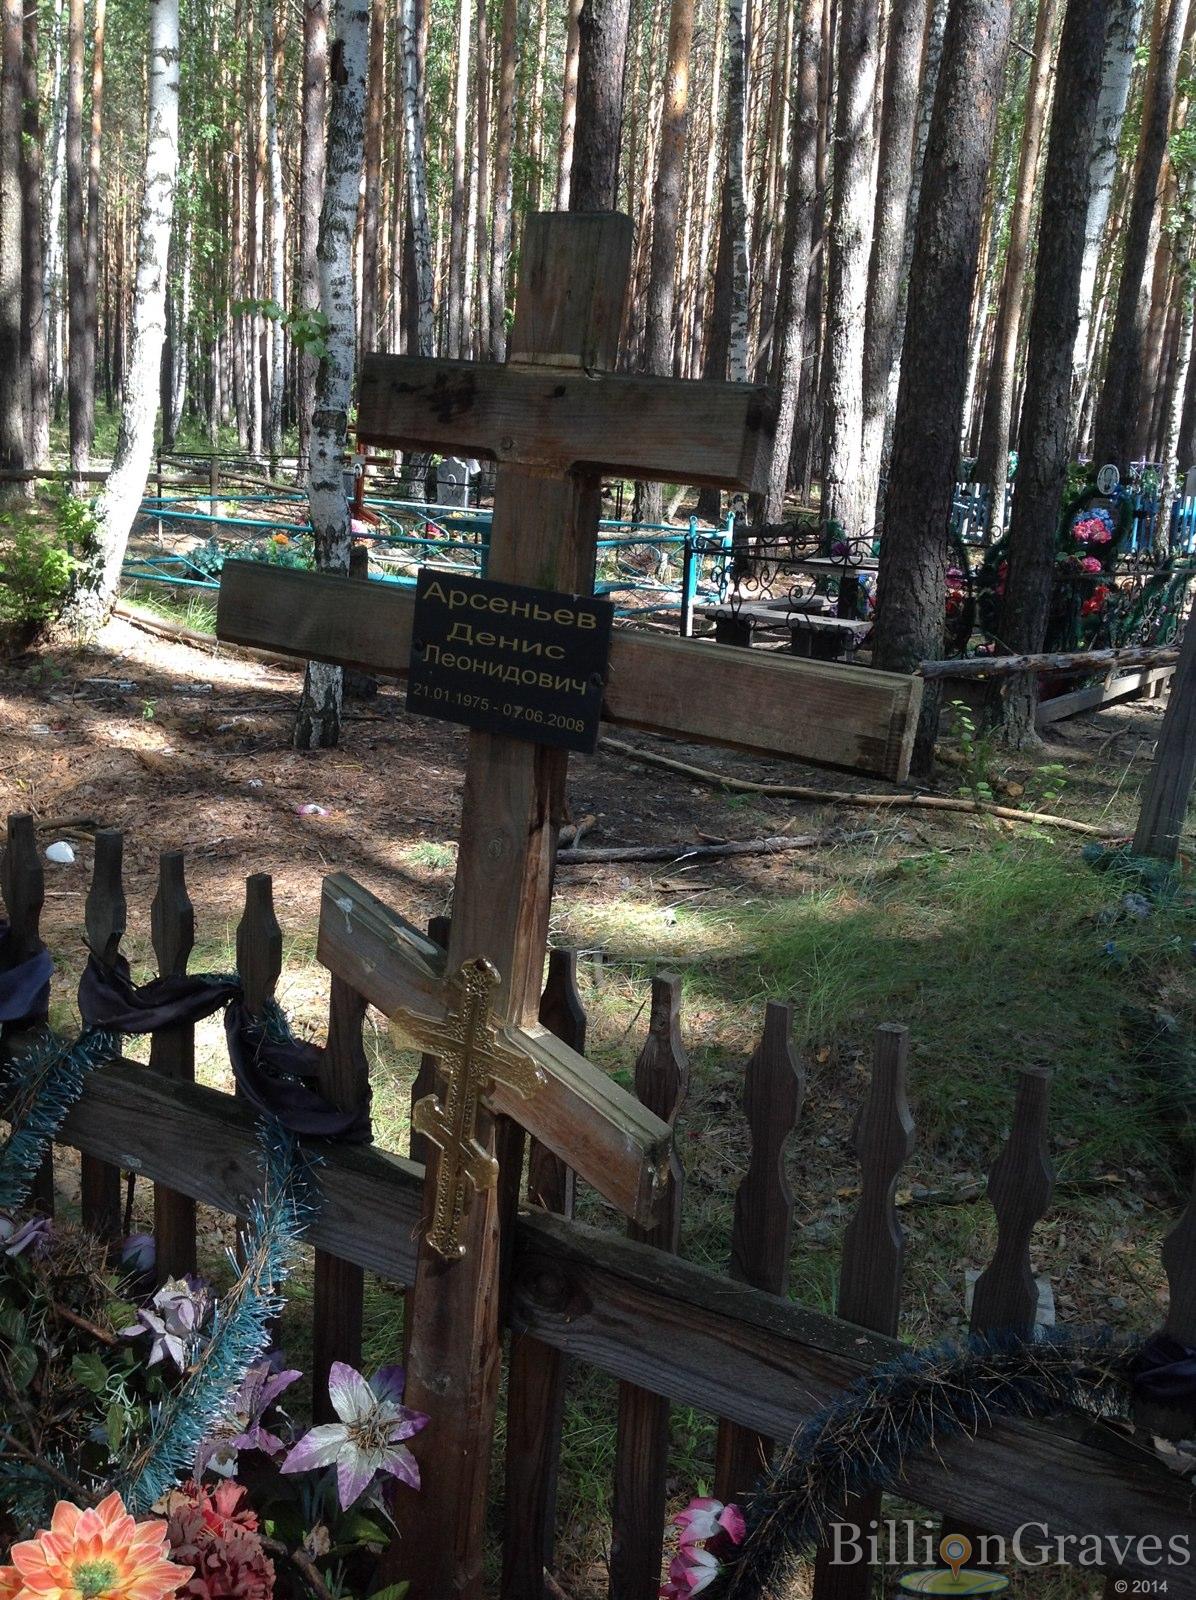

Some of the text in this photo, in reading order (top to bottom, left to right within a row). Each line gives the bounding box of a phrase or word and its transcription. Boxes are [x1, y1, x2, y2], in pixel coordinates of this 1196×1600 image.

[422, 581, 597, 630] Арсеньев
[446, 622, 566, 660] Денис
[422, 644, 587, 696] Леонидович
[413, 683, 489, 711] 21.01.1975
[503, 703, 585, 733] 07.06.2008
